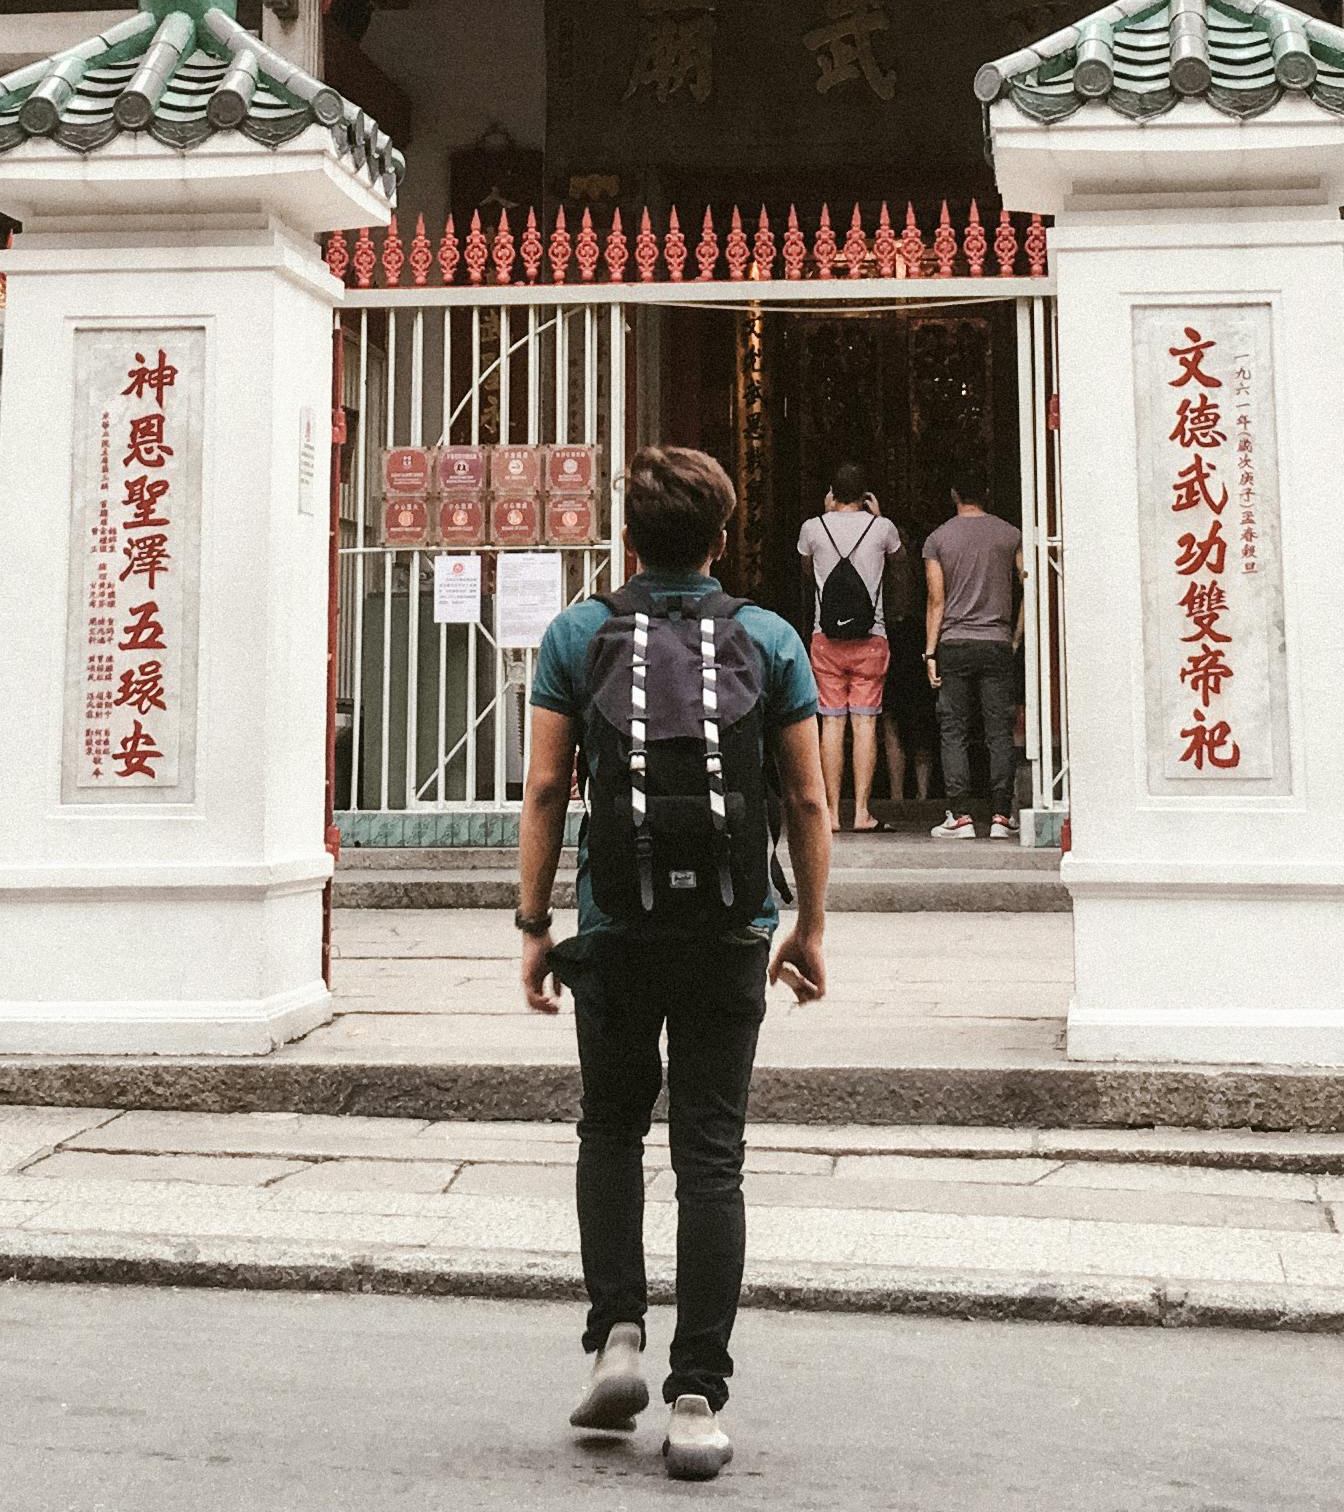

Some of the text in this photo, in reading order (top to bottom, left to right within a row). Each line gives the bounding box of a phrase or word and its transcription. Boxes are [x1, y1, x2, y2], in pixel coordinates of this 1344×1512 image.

[112, 348, 179, 779] 神恩聖澤五環安
[1167, 326, 1241, 771] 文德武功雙帝祀
